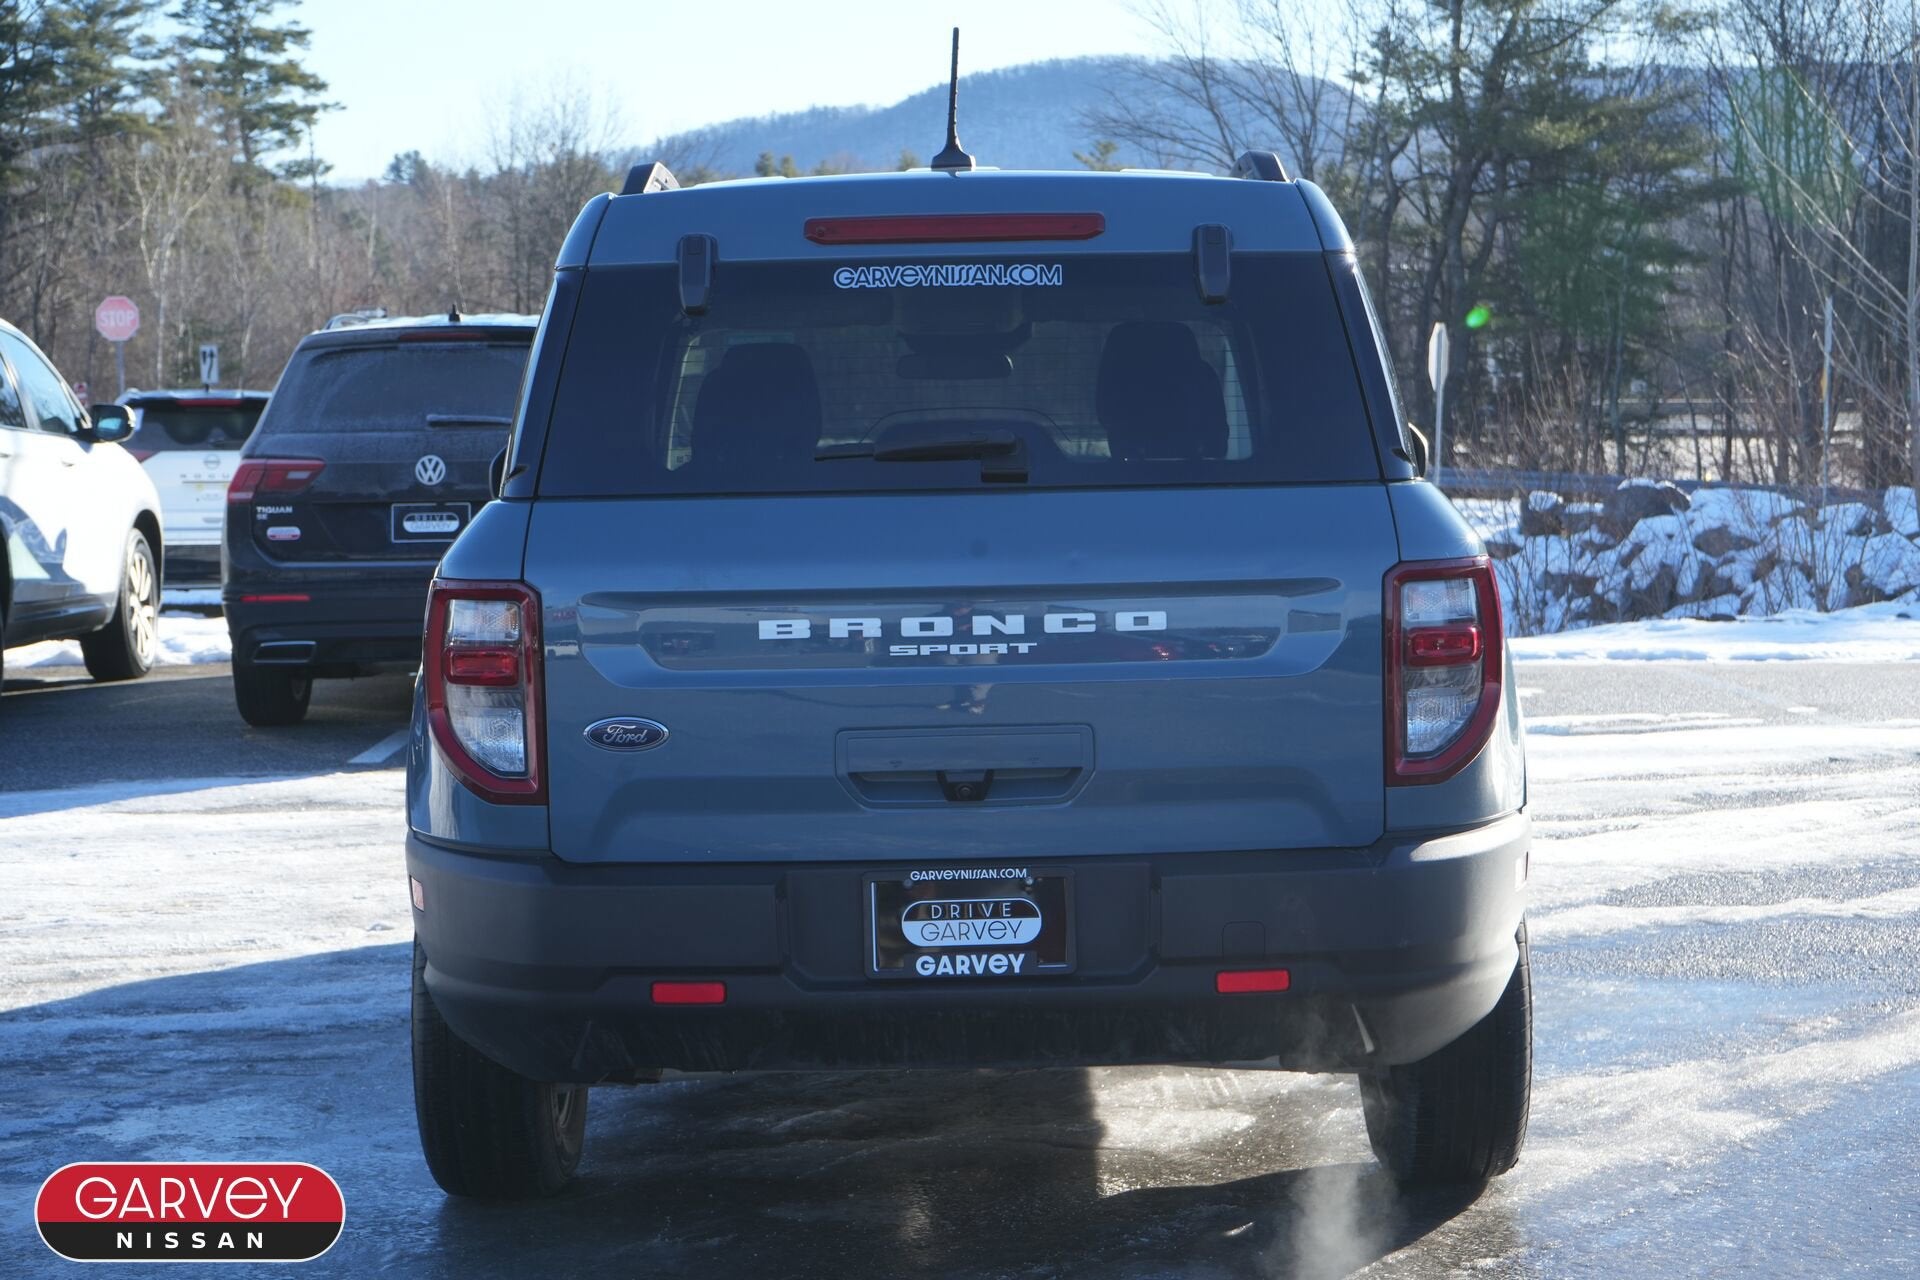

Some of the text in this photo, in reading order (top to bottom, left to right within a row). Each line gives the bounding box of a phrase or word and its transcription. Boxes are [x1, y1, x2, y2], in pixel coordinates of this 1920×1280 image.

[833, 264, 1063, 288] GARVEYNISSAN.COM
[100, 309, 135, 327] STOP
[758, 611, 1168, 640] BRONCO
[889, 642, 1038, 657] SPORT
[602, 724, 648, 743] Ford
[910, 868, 1027, 881] GARVEYNISSAN.COM
[931, 902, 1012, 919] DRIVE
[920, 920, 1022, 942] GARVEY
[915, 953, 1025, 976] GARVEY
